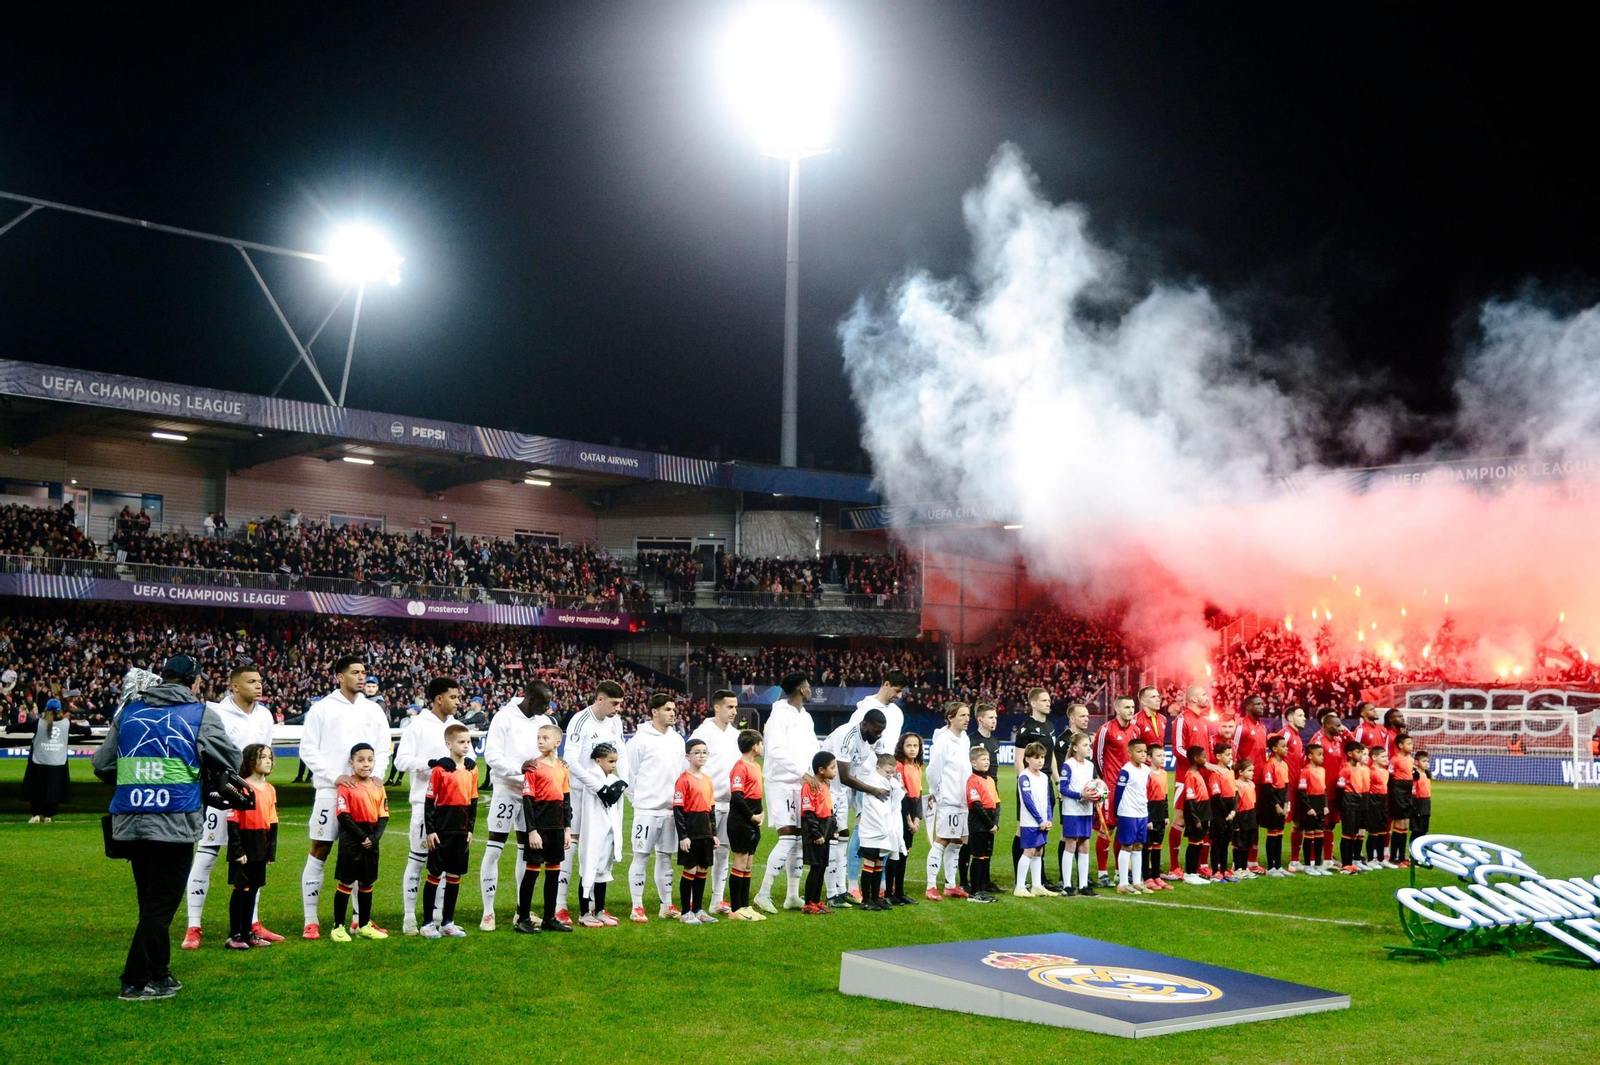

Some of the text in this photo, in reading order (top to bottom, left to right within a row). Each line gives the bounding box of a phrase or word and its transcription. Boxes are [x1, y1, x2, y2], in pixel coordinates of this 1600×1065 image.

[42, 375, 242, 415] UEFA CHAMPIONS LEAGUE
[412, 426, 446, 440] PEPSI
[580, 451, 639, 468] QATAR AIRWAYS
[927, 508, 953, 520] UEFA
[133, 584, 287, 606] UEFA CHAMPIONS LEAGUE
[427, 605, 469, 614] mastercard
[558, 614, 575, 623] enjoy
[576, 615, 611, 625] responsibly
[134, 761, 165, 780] HB
[130, 788, 171, 807] 020
[318, 808, 329, 825] 5
[496, 802, 515, 820] 23
[207, 812, 218, 830] 9
[948, 814, 959, 828] 10
[635, 823, 650, 840] 21
[1395, 875, 1600, 930] CHAMPI
